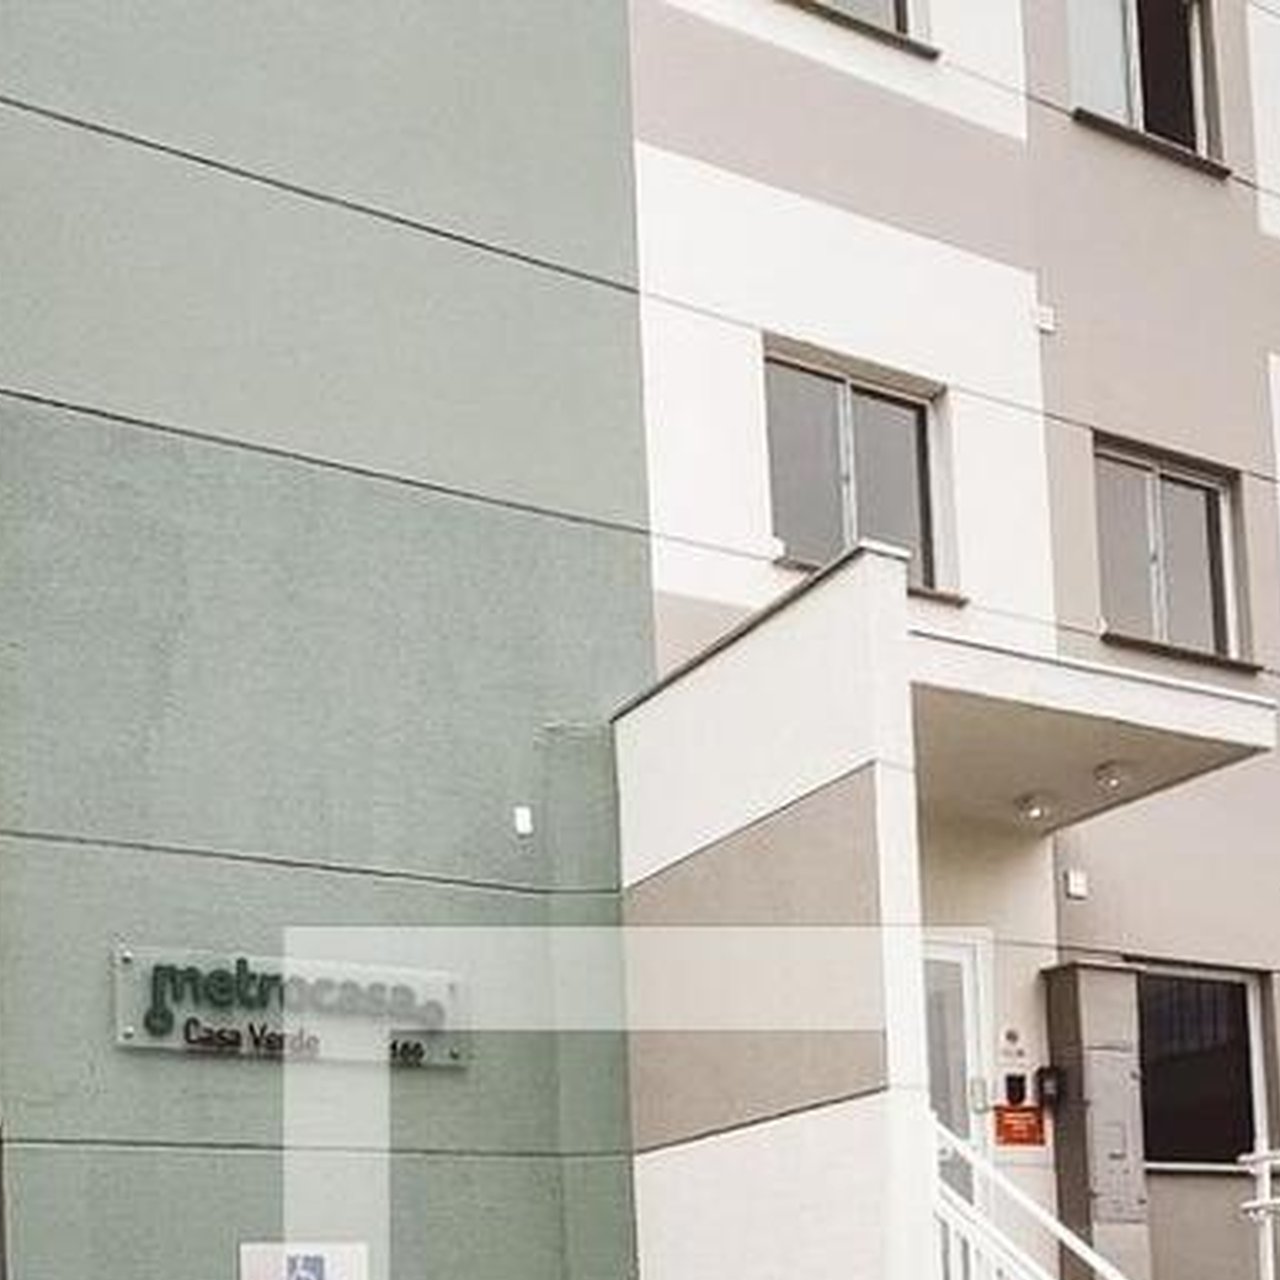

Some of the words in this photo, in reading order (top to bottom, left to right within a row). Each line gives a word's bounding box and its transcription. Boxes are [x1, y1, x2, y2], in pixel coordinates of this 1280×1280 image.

[145, 957, 445, 1029] metrocasa
[184, 1017, 241, 1047] Casa
[249, 1023, 320, 1053] Verde
